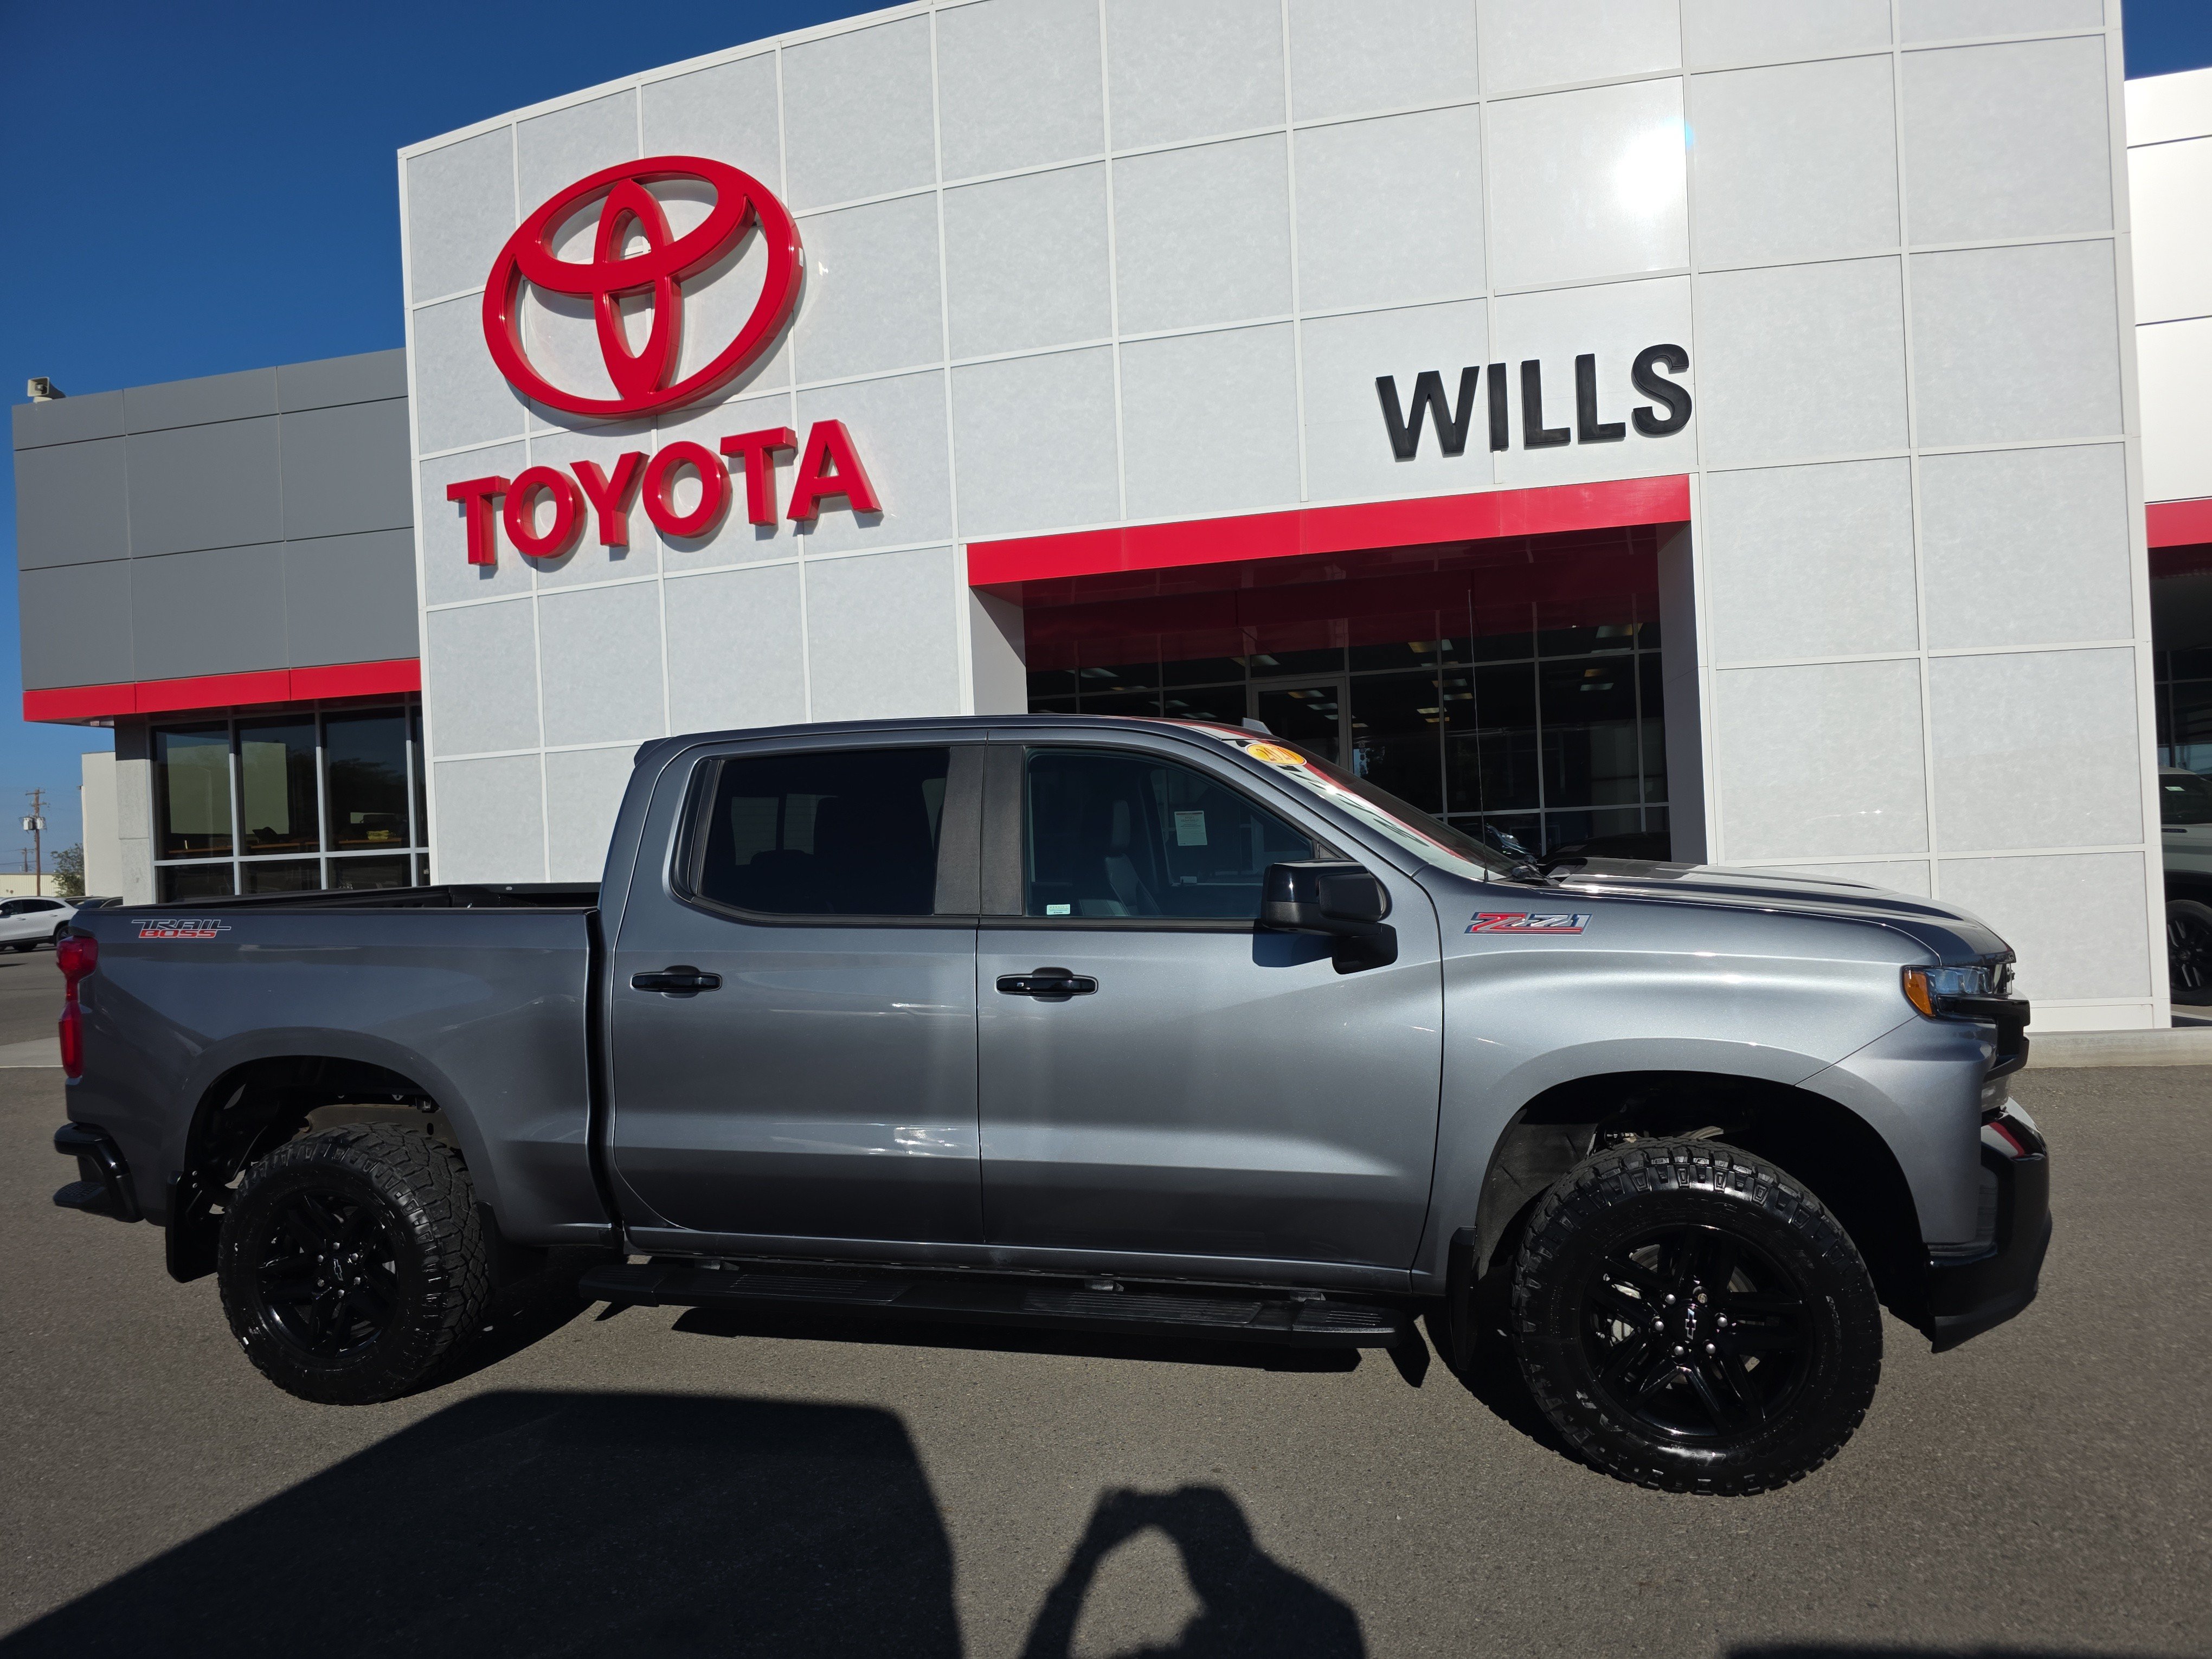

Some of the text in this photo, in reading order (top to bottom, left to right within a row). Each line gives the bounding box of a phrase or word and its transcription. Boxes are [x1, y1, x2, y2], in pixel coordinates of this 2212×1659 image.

[1375, 344, 1692, 461] WILLS
[447, 419, 883, 566] TOYOTA
[131, 919, 232, 930] TRAIL
[138, 929, 217, 938] BOSS
[1464, 912, 1593, 935] Z71
